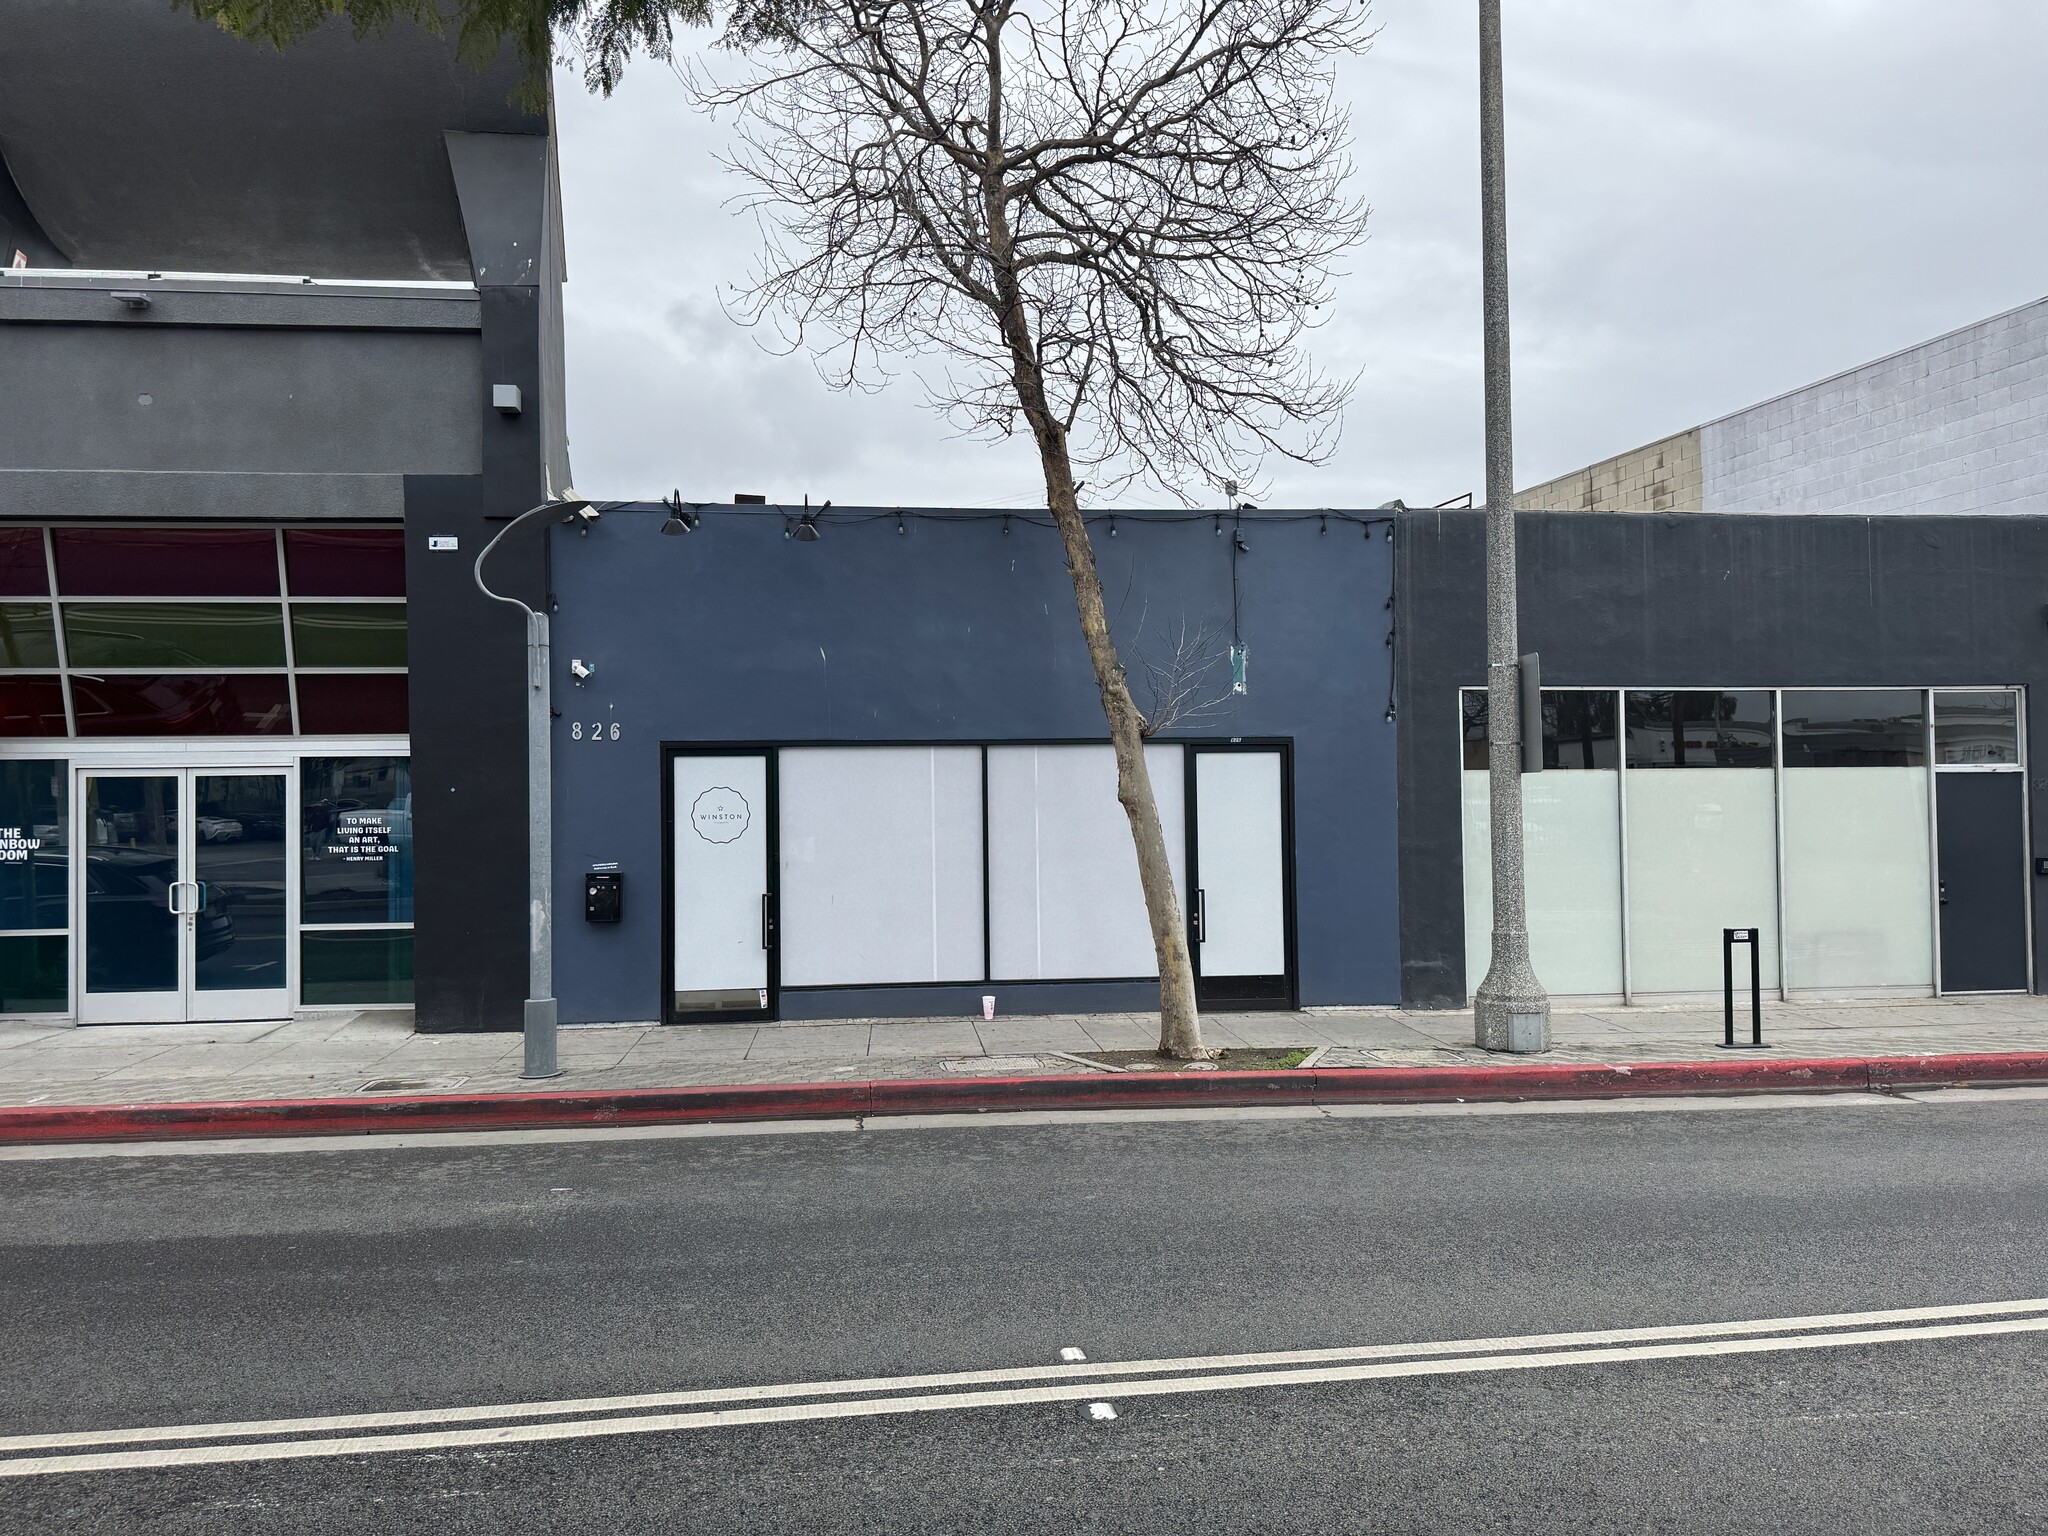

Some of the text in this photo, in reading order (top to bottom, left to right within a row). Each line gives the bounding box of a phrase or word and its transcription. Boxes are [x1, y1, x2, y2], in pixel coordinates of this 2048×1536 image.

[572, 721, 620, 741] 826
[346, 817, 382, 825] TO MAKE
[0, 838, 40, 849] NBOW
[362, 836, 380, 844] ART,
[360, 845, 376, 853] THE
[378, 845, 399, 853] GOAL
[0, 850, 27, 860] OOM
